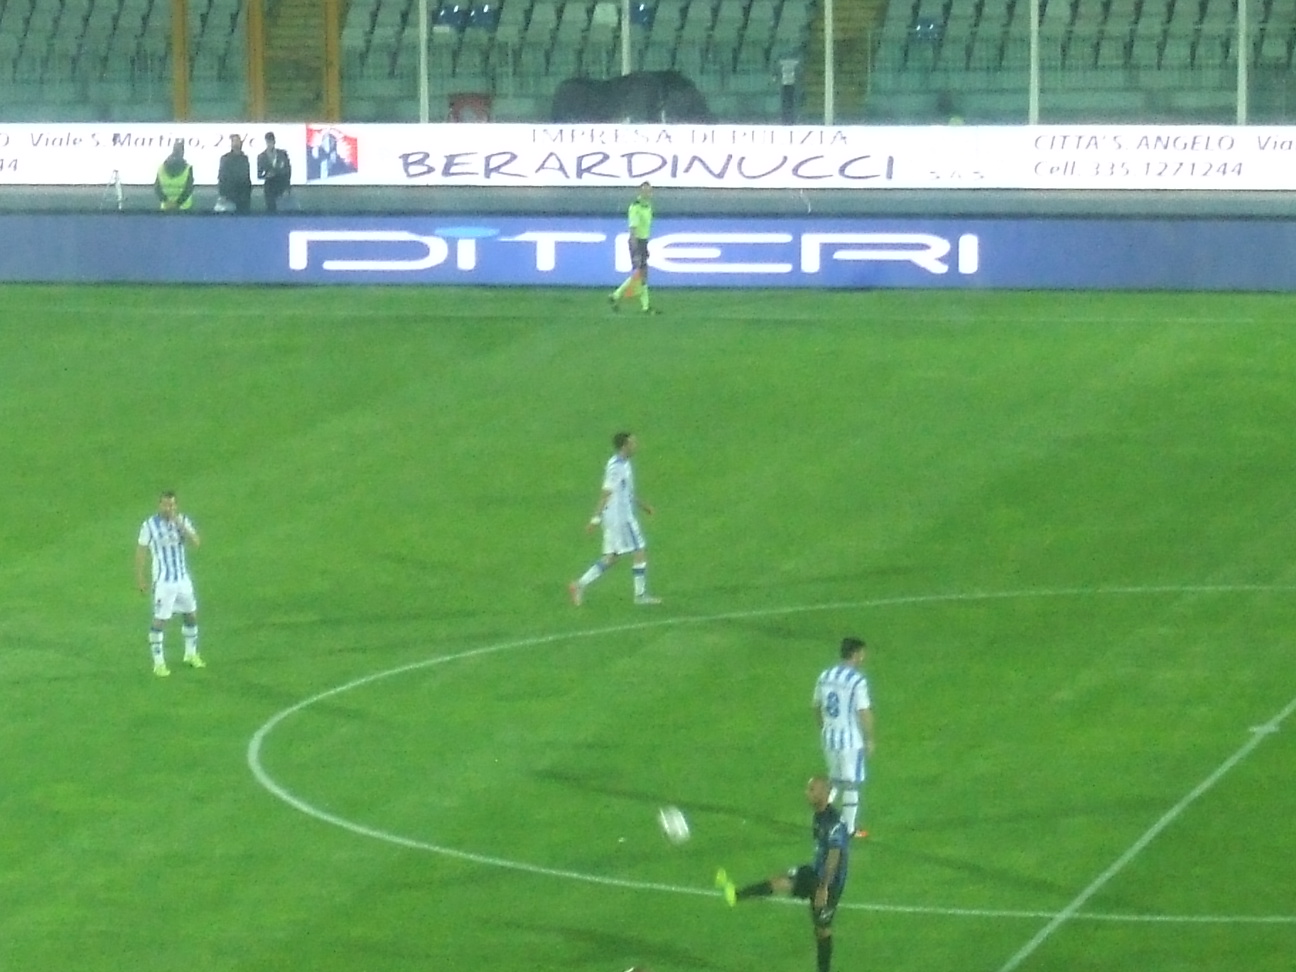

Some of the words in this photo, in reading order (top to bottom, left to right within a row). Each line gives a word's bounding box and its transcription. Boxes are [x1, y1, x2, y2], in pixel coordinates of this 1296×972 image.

[31, 132, 83, 147] Viale
[531, 128, 673, 144] IMPRESA
[1136, 135, 1235, 150] ANGELO
[399, 151, 894, 181] BERARDINUCCI
